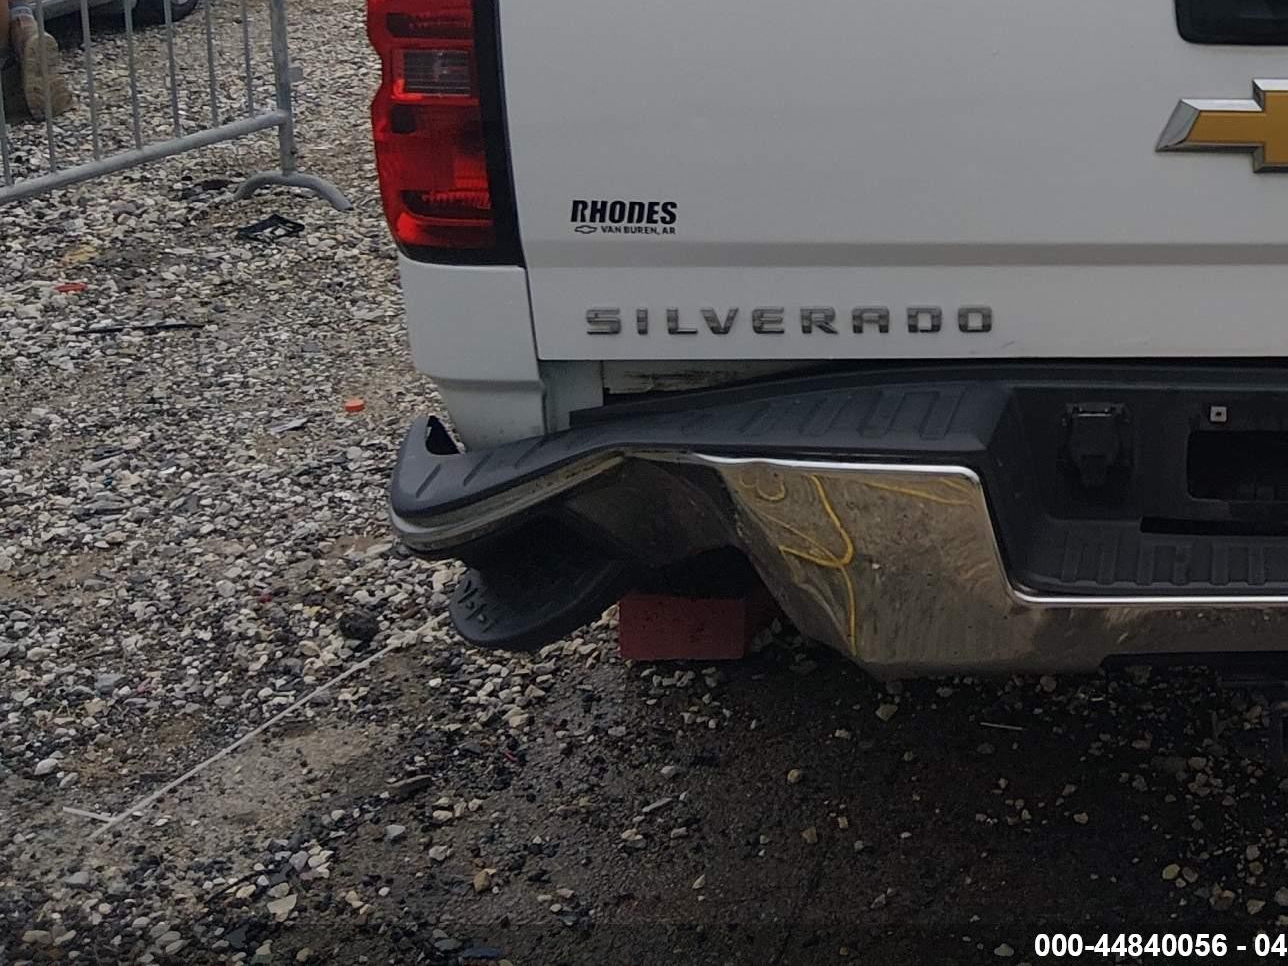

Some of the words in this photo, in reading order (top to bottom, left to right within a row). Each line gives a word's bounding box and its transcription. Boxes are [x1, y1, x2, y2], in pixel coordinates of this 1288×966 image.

[570, 200, 678, 225] RHODES
[601, 225, 621, 234] VAN
[623, 226, 660, 235] BUREN,
[662, 226, 676, 234] AR
[586, 307, 993, 335] SILVERADO
